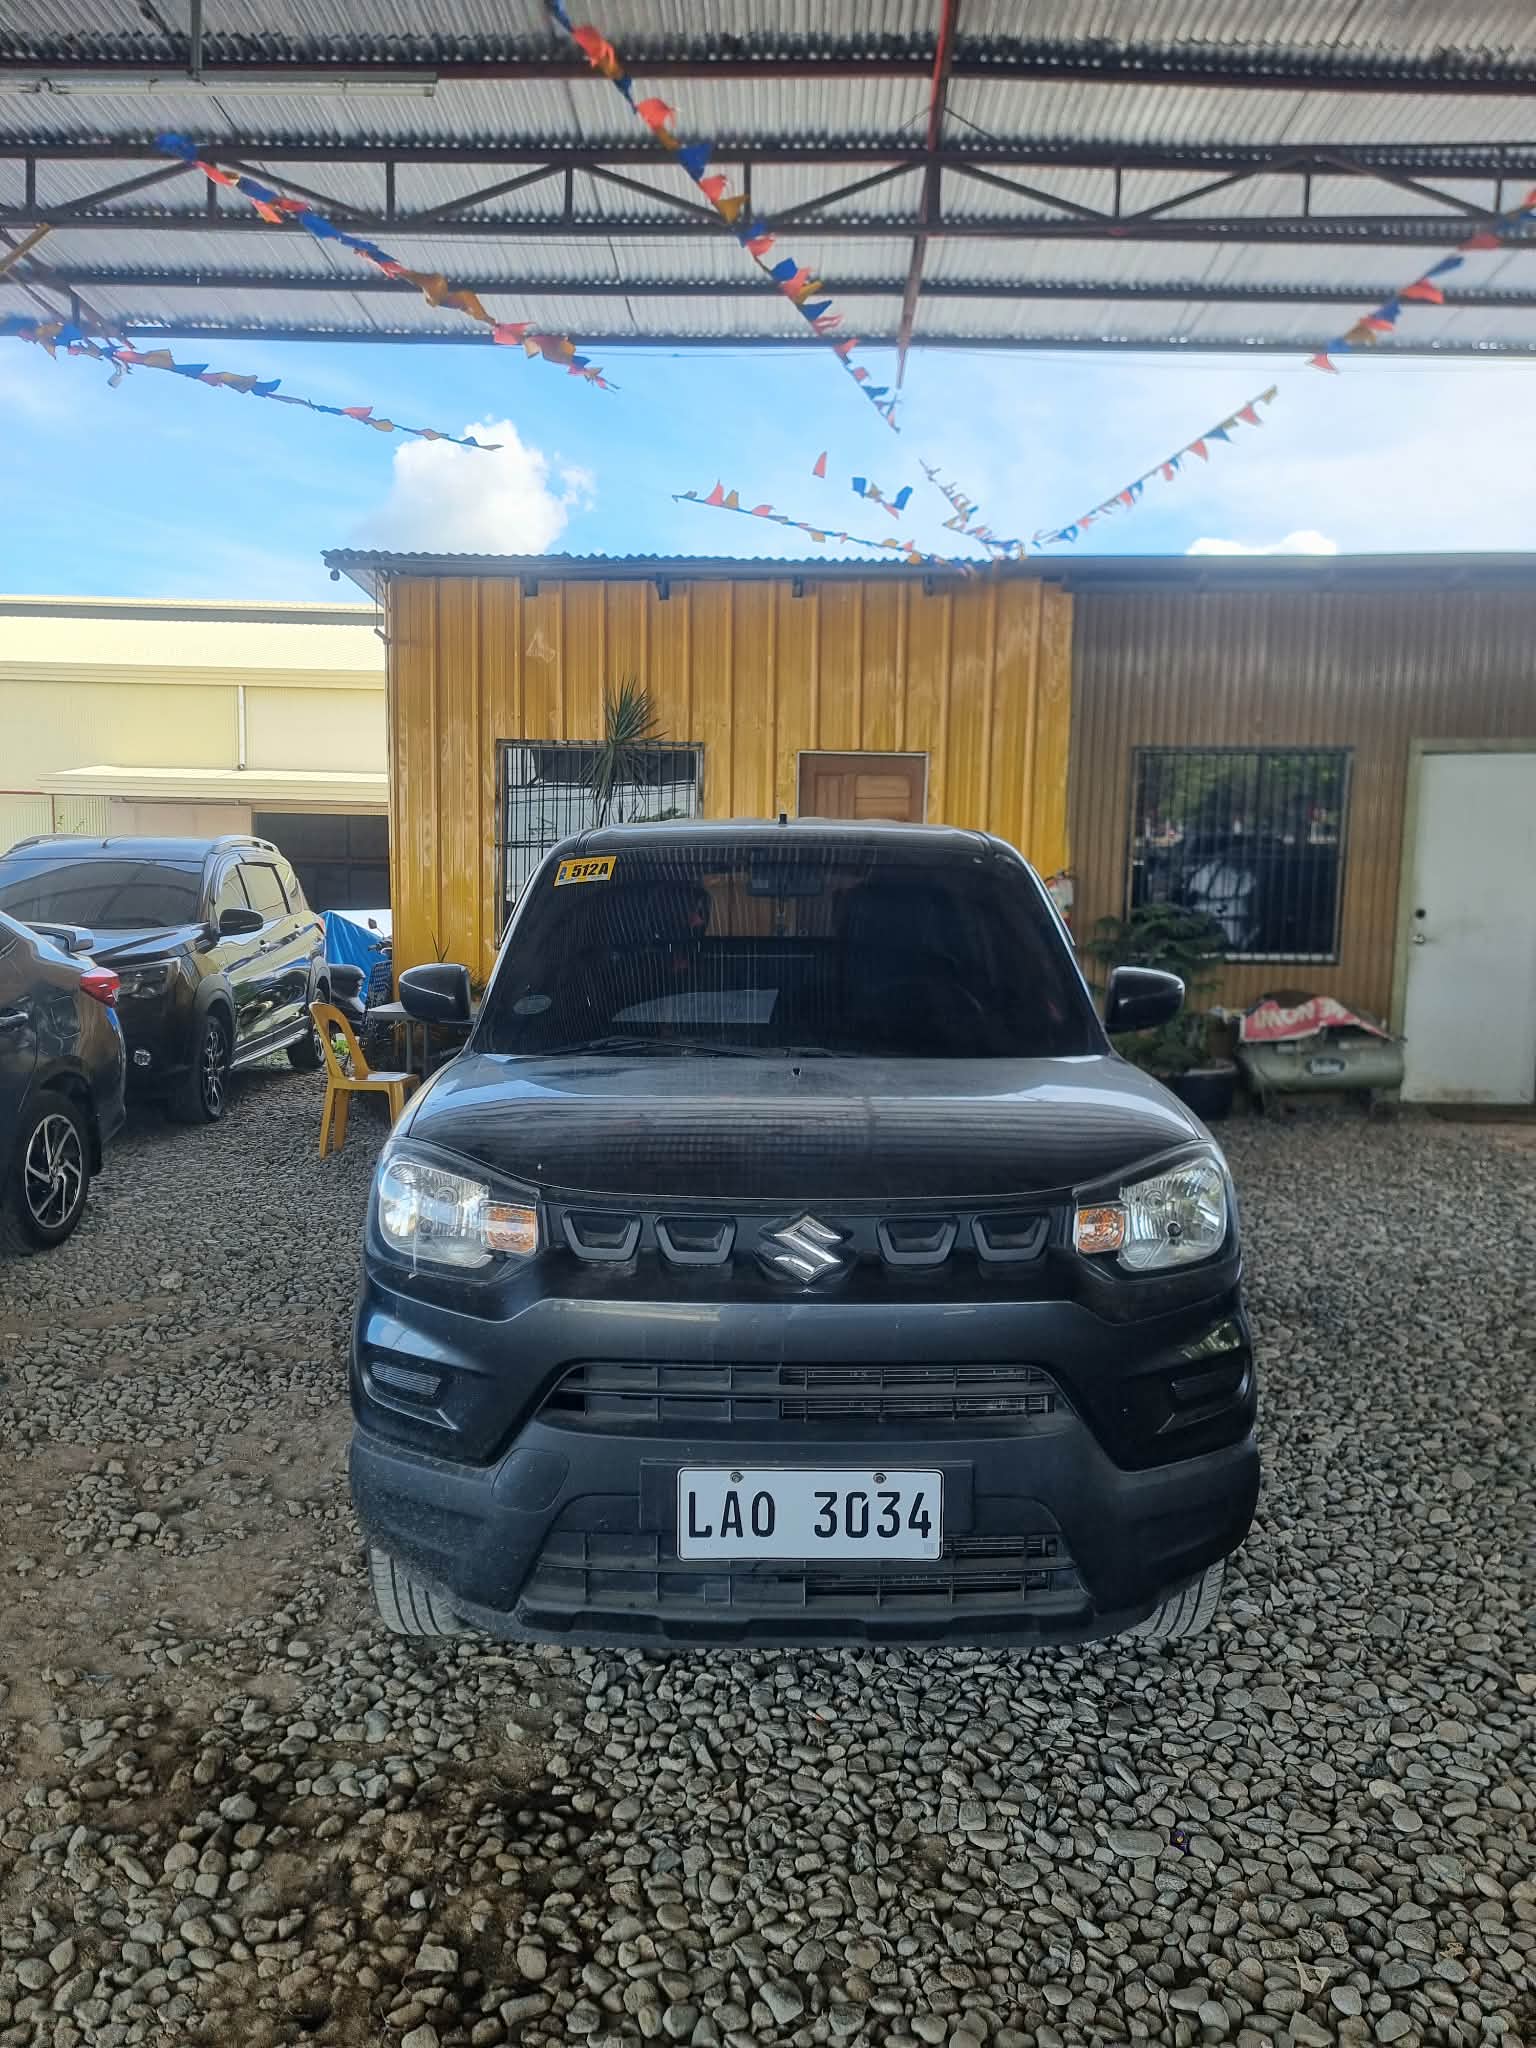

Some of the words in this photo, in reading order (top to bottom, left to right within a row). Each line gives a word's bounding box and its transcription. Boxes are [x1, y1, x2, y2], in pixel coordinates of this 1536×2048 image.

[571, 862, 609, 877] 512A
[688, 1491, 775, 1538] LAO
[814, 1491, 932, 1538] 3034
